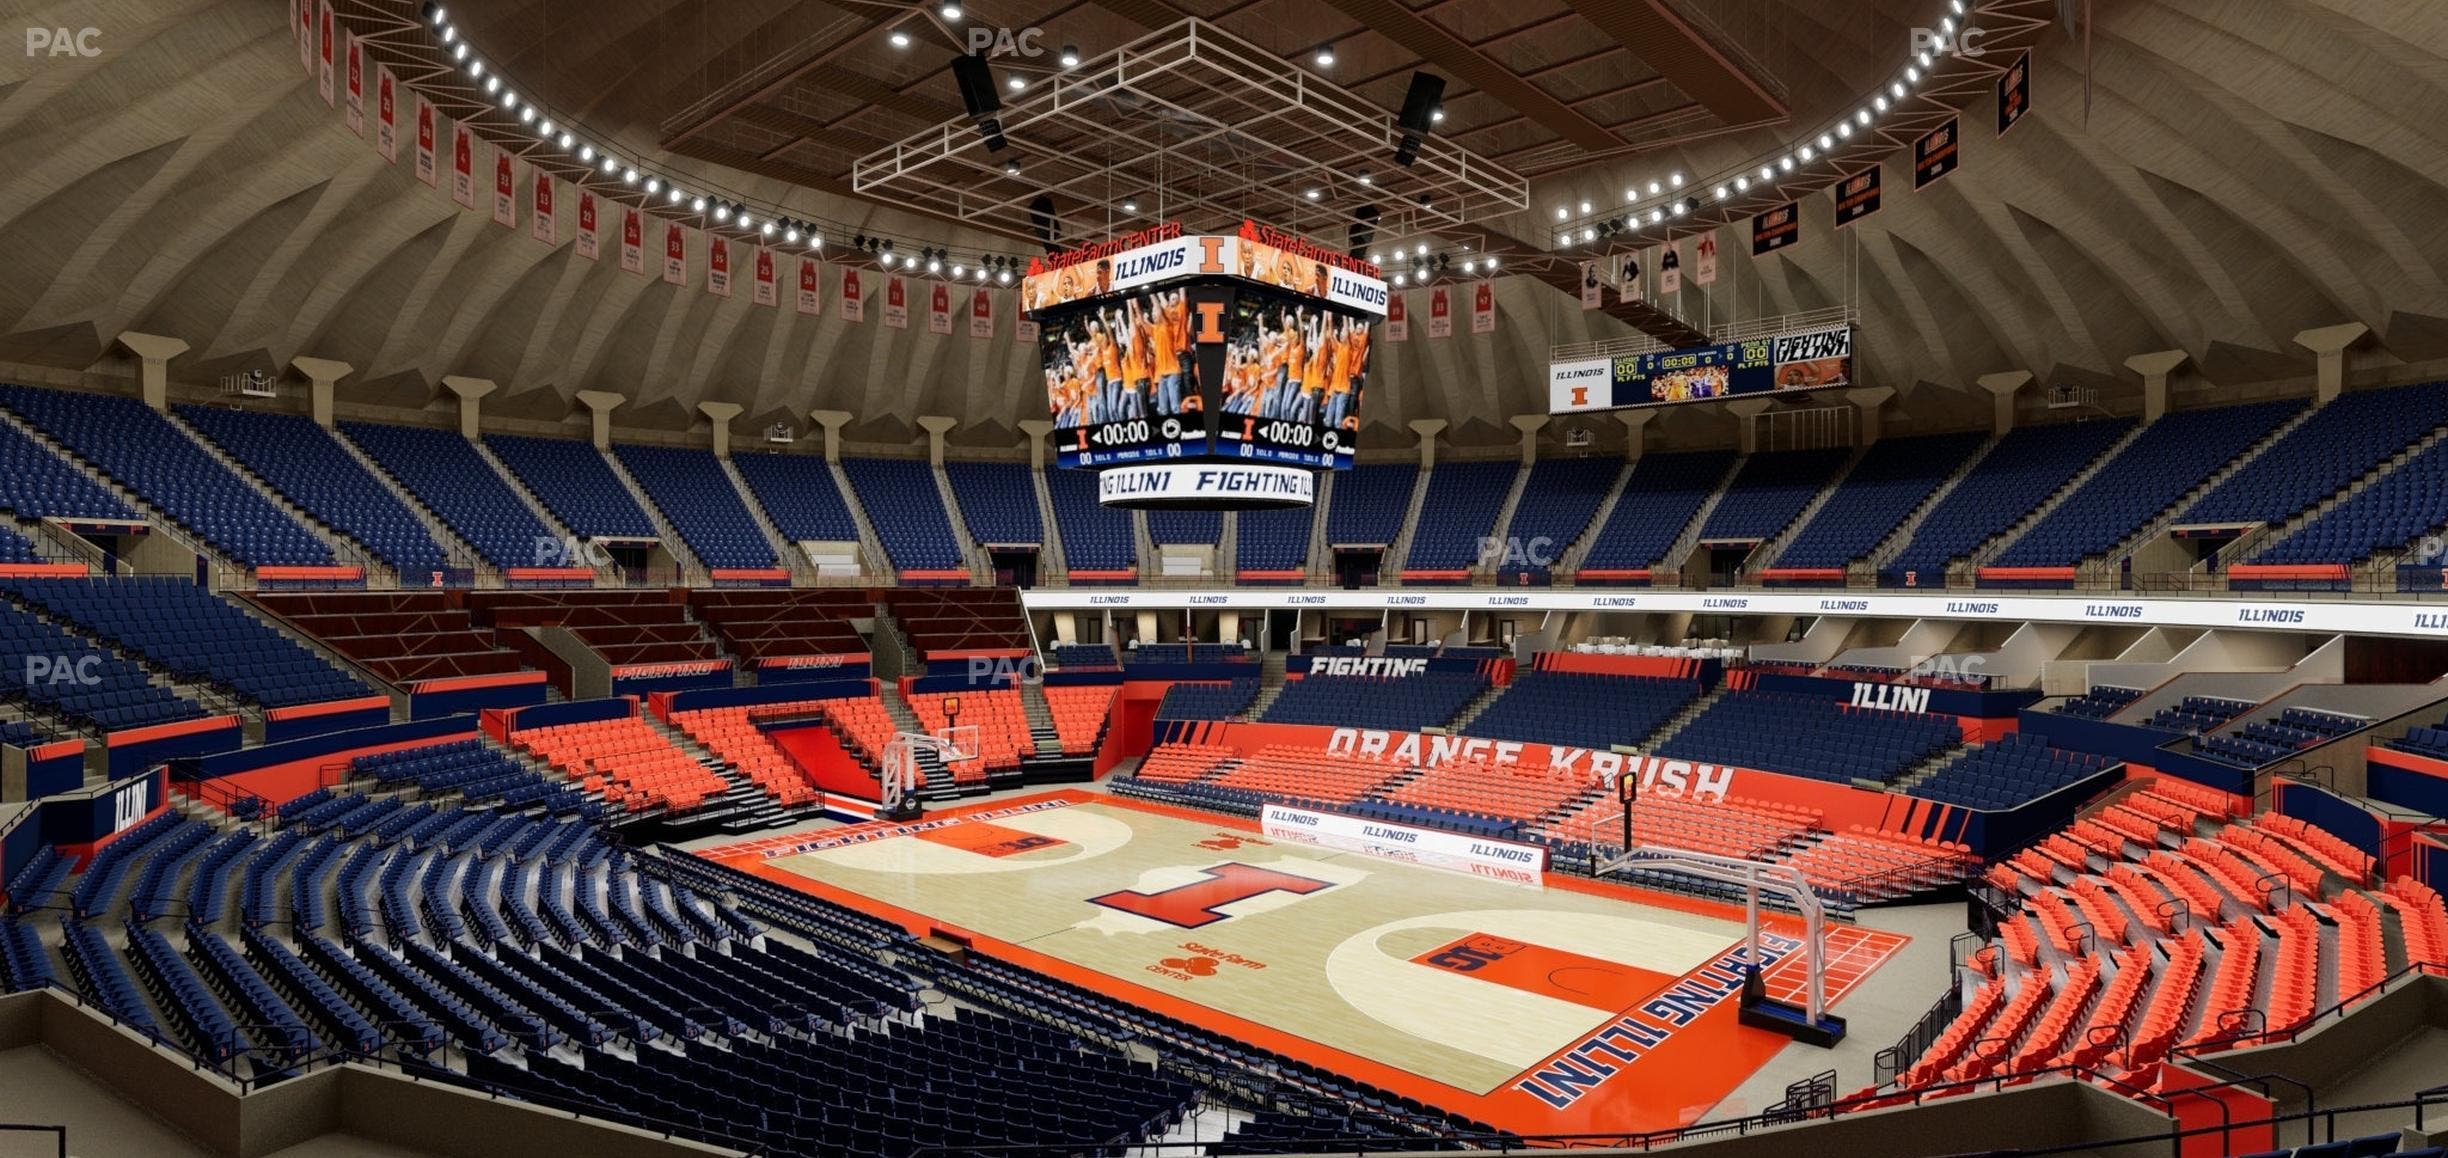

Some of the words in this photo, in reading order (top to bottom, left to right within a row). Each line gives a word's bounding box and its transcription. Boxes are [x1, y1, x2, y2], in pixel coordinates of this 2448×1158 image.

[1115, 247, 1186, 281] ILLINOIS
[1331, 276, 1387, 305] ILLINOIS
[1664, 356, 1695, 368] 00:00
[1556, 368, 1604, 380] ILLINOIS
[1102, 420, 1149, 445] 00:00
[1269, 421, 1313, 447] 00:00
[1167, 443, 1182, 457] 00
[1240, 443, 1254, 457] 00
[1079, 452, 1092, 465] 00
[1321, 453, 1334, 466] 00
[1116, 472, 1172, 494] ILLINI
[1196, 472, 1298, 494] FIGHTING
[1090, 595, 1130, 604] ILLINOIS
[1189, 595, 1228, 604] ILLINOIS
[1287, 595, 1327, 604] ILLINOIS
[1386, 596, 1426, 604] ILLINOIS
[1488, 596, 1529, 605] ILLINOIS
[1593, 597, 1636, 607] ILLINOIS
[1702, 598, 1748, 608] ILLINOIS
[1820, 600, 1869, 611] ILLINOIS
[1946, 602, 1999, 614] ILLINOIS
[2085, 605, 2143, 618] ILLINOIS
[2239, 609, 2305, 624] ILLINOIS
[1310, 656, 1428, 678] FIGHTING
[1850, 682, 1931, 714] ILLINI
[1270, 809, 1319, 826] ILLINOIS
[1362, 825, 1418, 843] ILLINOIS
[1470, 843, 1534, 863] ILLINOIS
[1517, 1017, 1674, 1111] ILLINI
